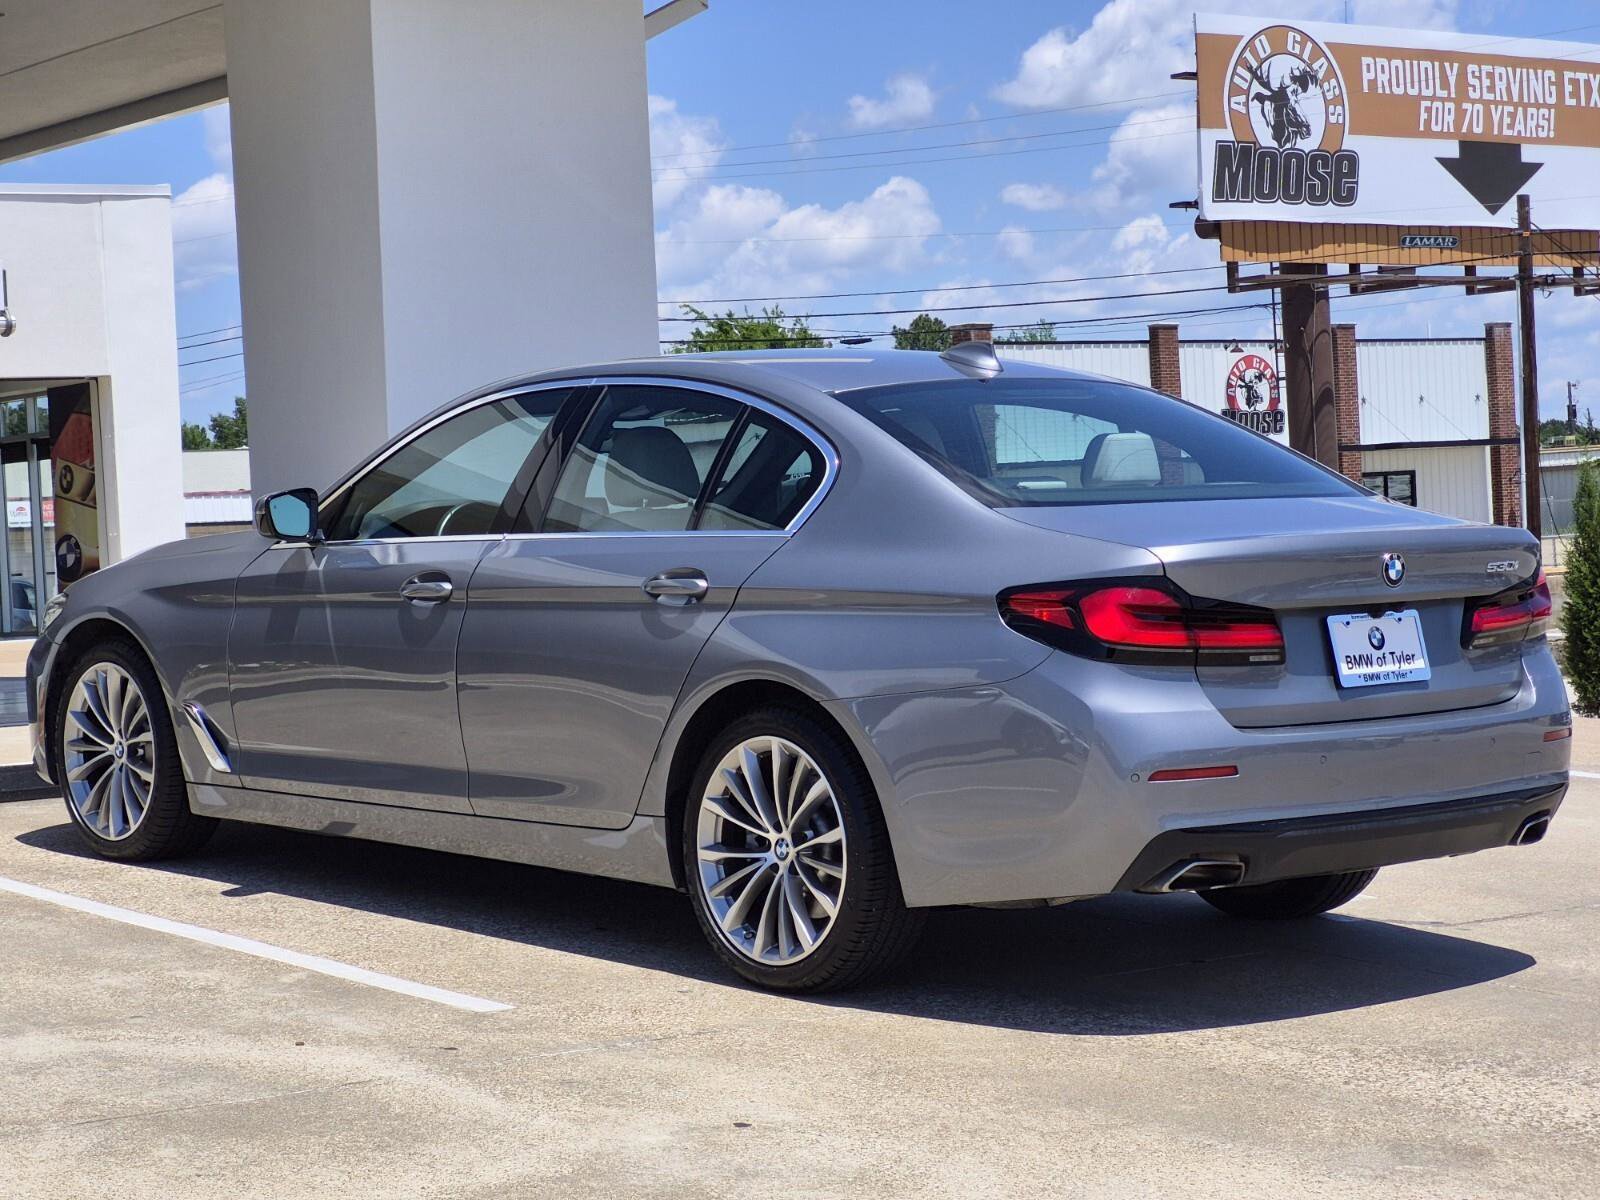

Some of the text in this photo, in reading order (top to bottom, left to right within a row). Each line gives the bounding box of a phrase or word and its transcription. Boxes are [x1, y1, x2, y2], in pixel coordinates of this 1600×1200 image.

[1231, 31, 1343, 125] AUTO GLASS
[1361, 56, 1600, 108] PROUDLY SERVING ETX
[1419, 100, 1555, 138] FOR 70 YEARS!
[1405, 236, 1453, 246] LAMAR
[1228, 360, 1246, 396] AUTO
[1345, 651, 1415, 670] BMW of Tyler
[1363, 670, 1408, 682] BMW of Tyler
